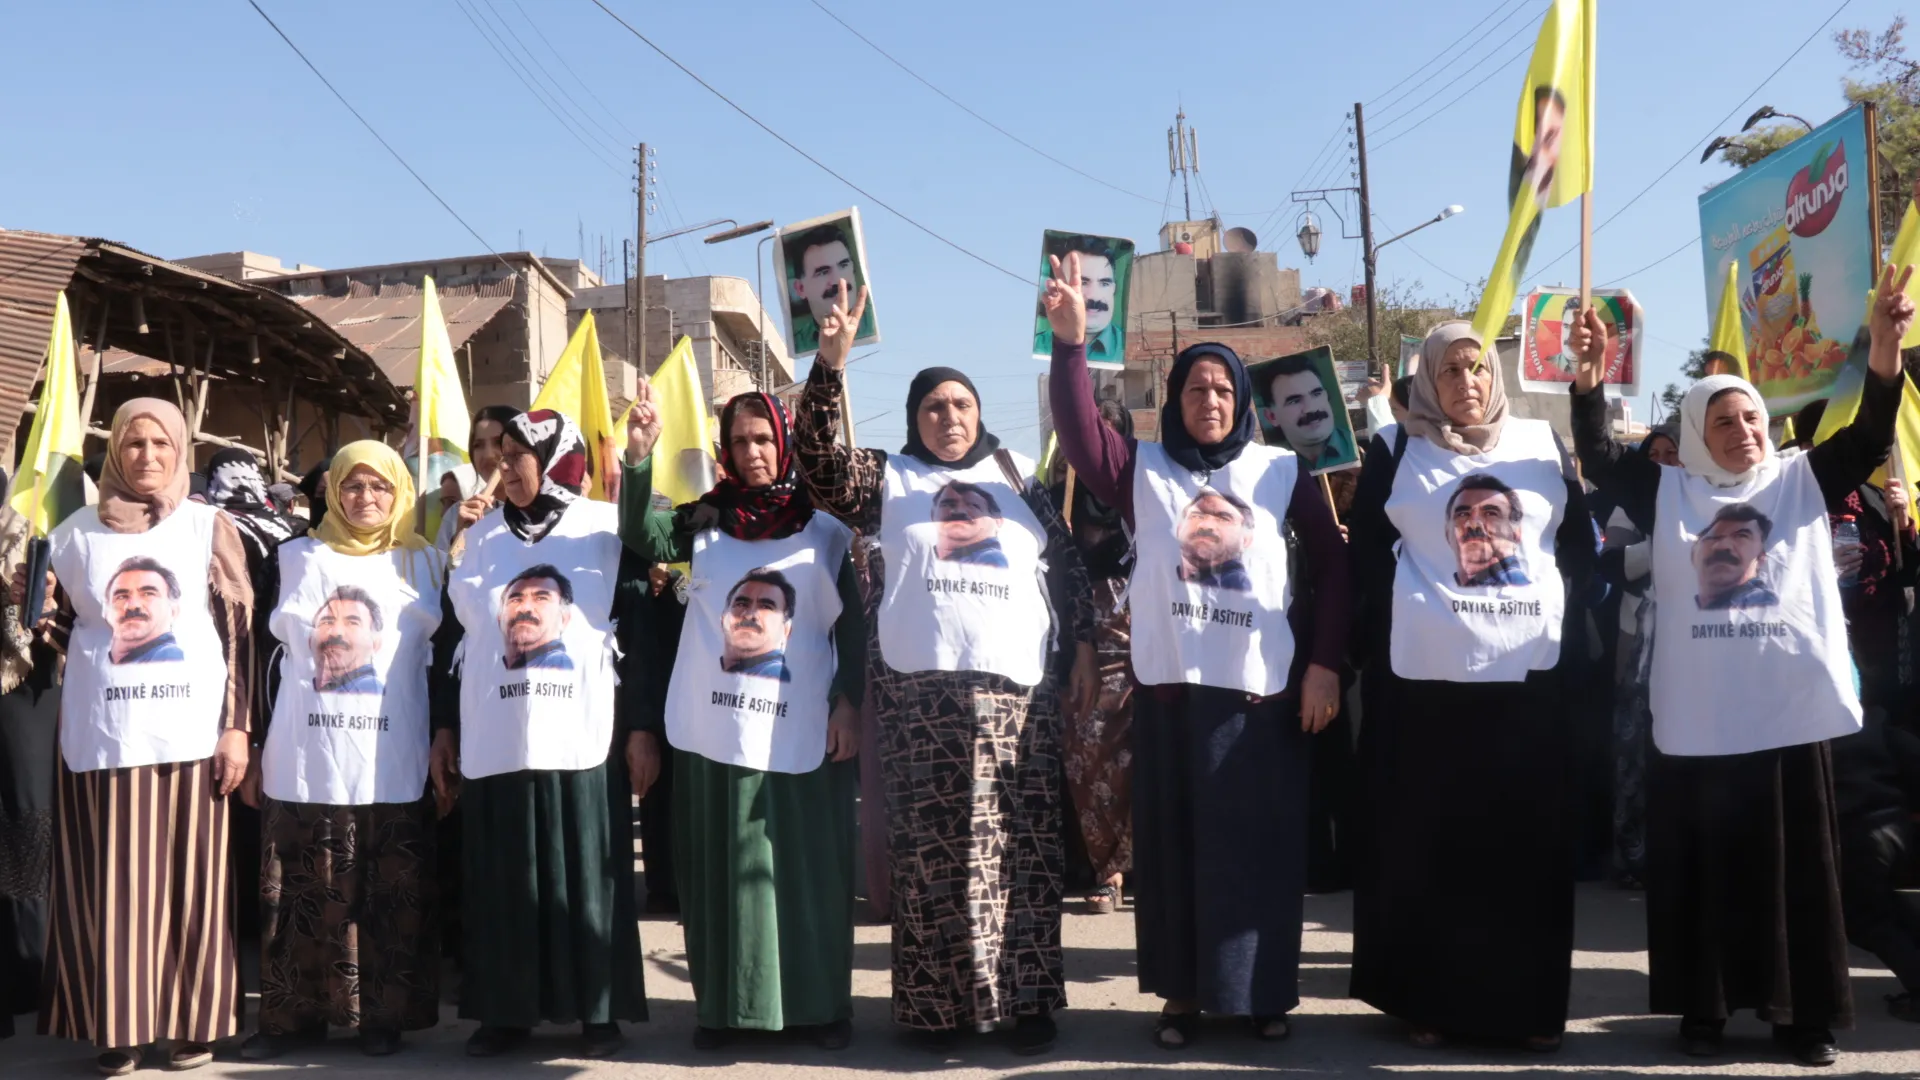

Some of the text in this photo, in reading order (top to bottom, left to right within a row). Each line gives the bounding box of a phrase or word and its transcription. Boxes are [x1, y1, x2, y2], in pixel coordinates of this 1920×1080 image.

[1785, 160, 1848, 233] altunsa
[927, 578, 966, 593] DAYIKÊ
[1172, 602, 1208, 620] DAYIKÊ
[1692, 621, 1735, 639] DAYIKÊ
[106, 683, 146, 701] DAYIKÊ
[500, 679, 530, 699] DAYIKÊ
[712, 691, 745, 709] DAYIKÊ
[308, 712, 344, 728] DAYIKÊ
